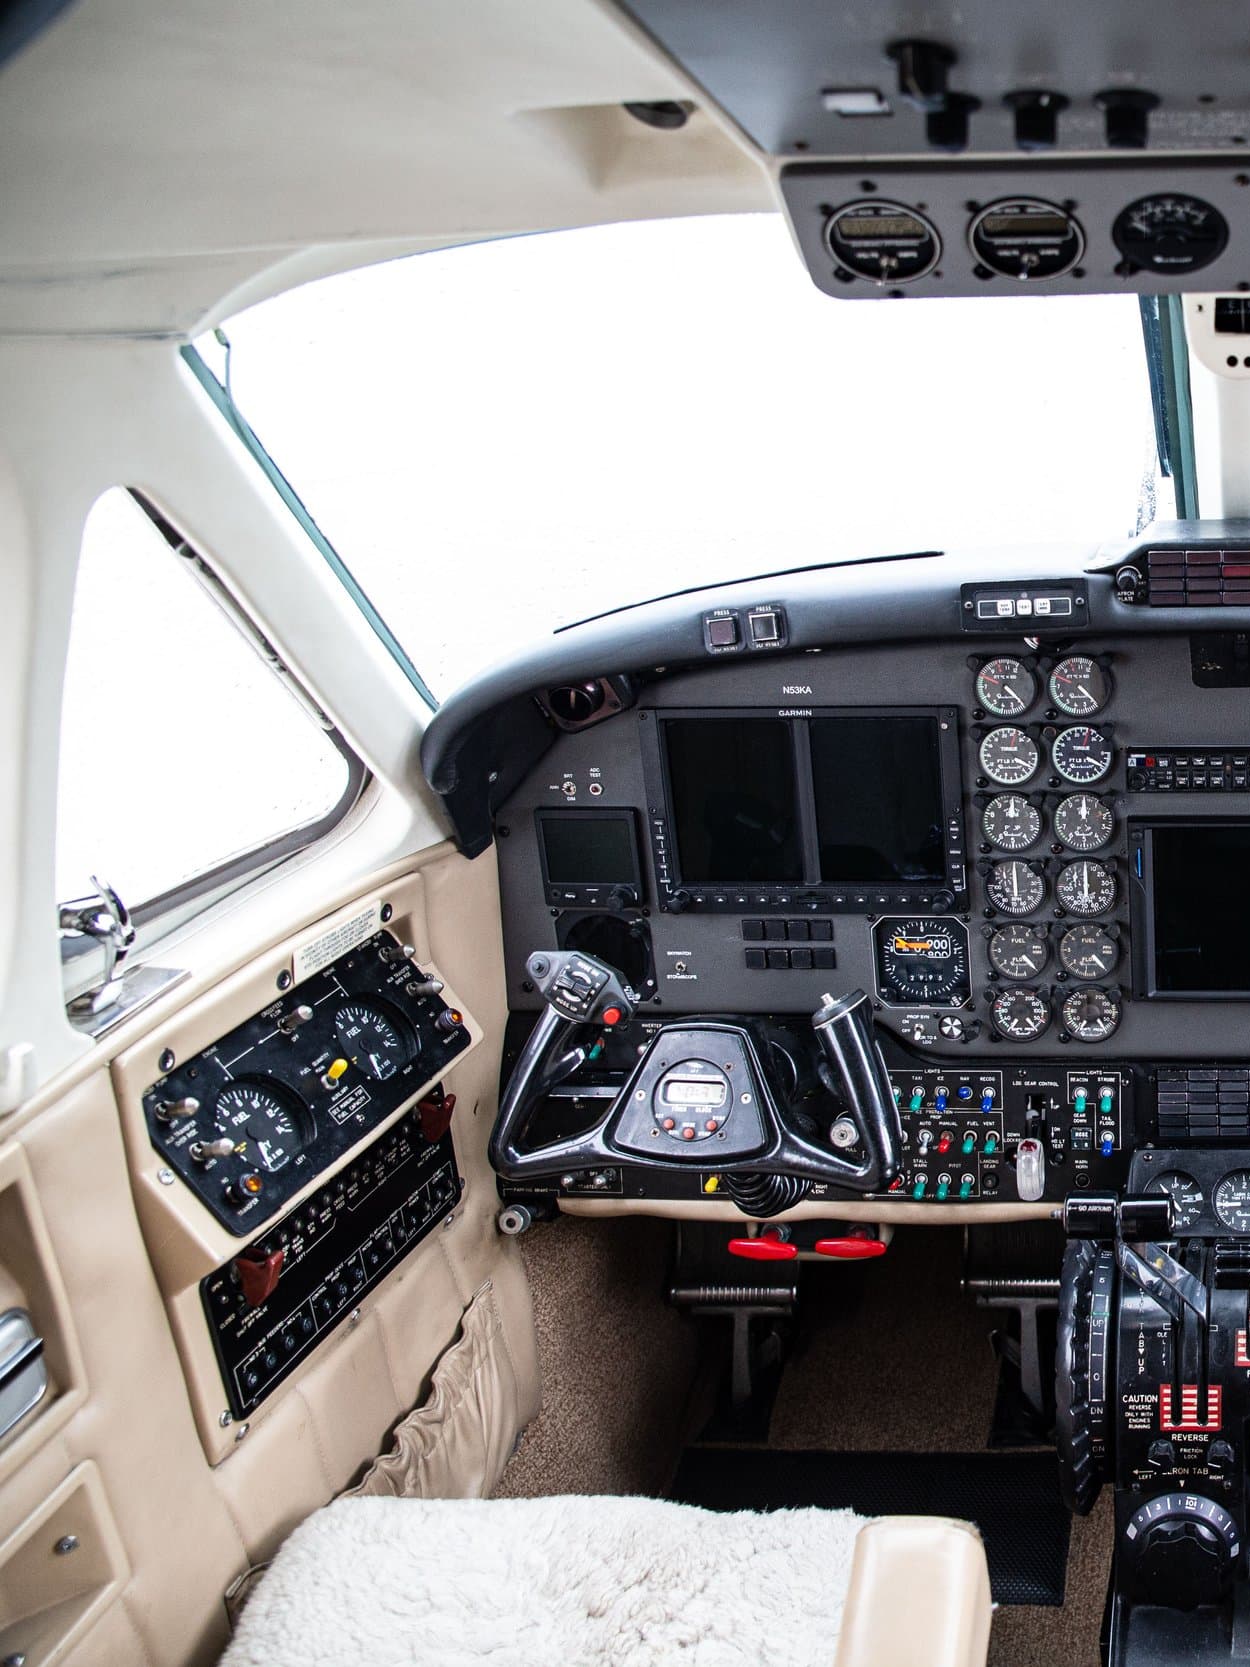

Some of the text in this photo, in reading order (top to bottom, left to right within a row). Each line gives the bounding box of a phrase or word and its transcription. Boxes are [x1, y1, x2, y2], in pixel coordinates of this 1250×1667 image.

[783, 686, 812, 694] N53KA
[346, 1027, 362, 1039] FUEL
[231, 1112, 251, 1126] FUEL
[1092, 1319, 1104, 1327] UP
[1122, 1394, 1158, 1403] CAUTION
[1090, 1406, 1103, 1415] DN
[1171, 1434, 1209, 1442] REVERSE
